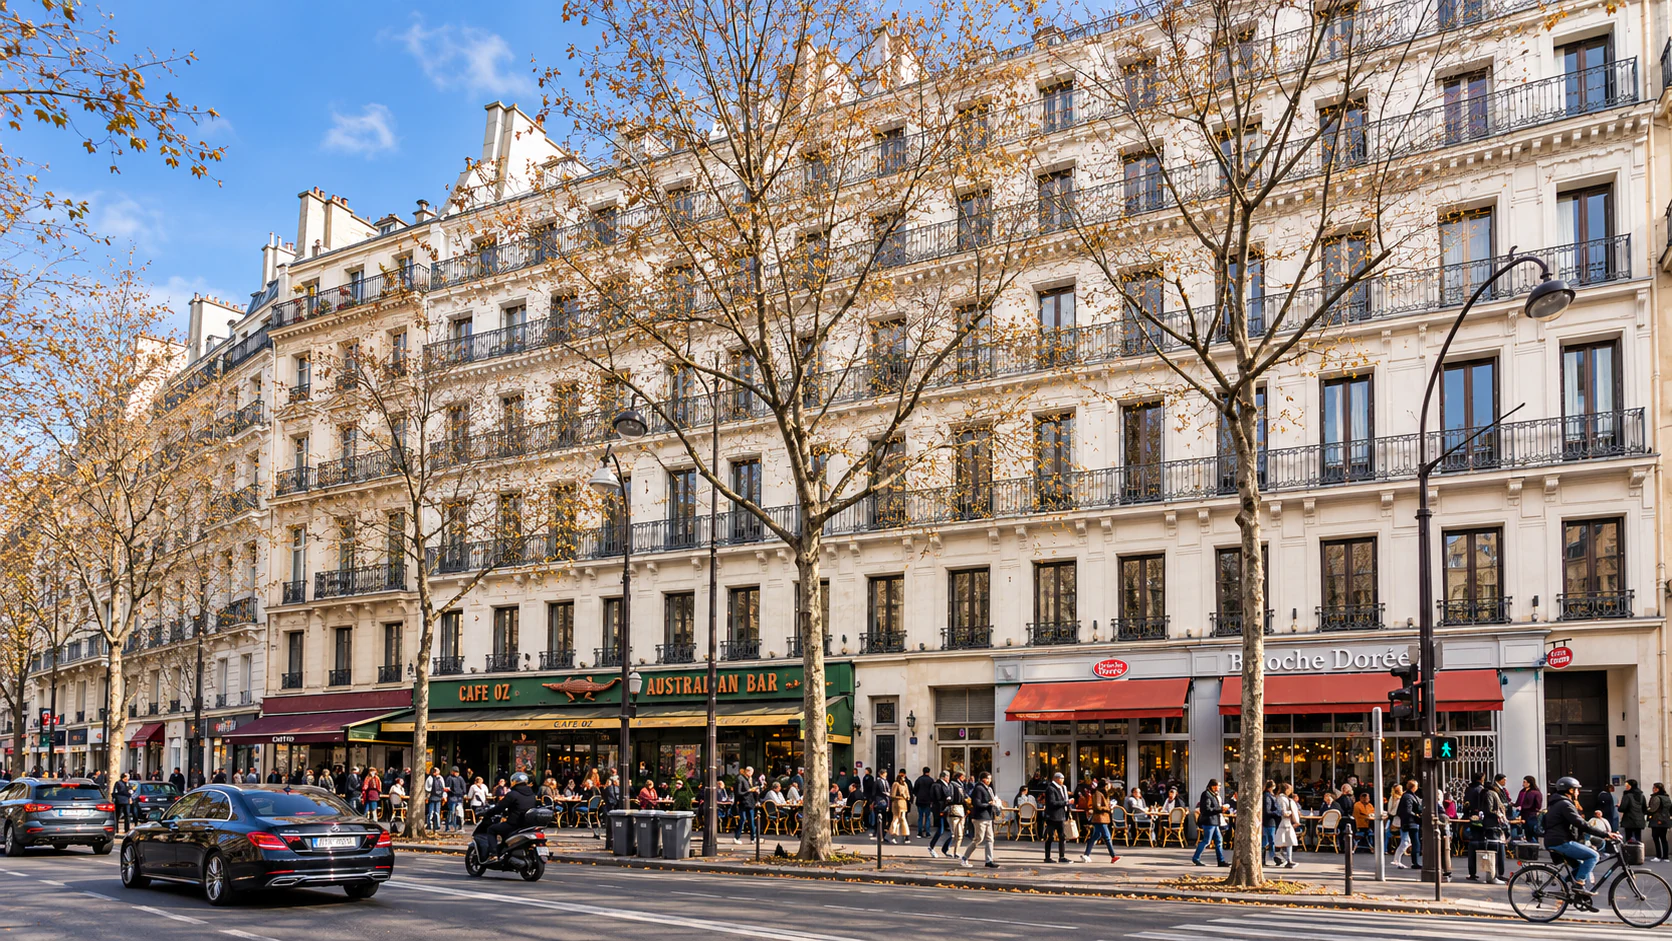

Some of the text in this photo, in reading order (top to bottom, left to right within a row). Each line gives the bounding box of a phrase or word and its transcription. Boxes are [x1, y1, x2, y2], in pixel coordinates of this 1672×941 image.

[1228, 647, 1412, 673] Boche Dorée
[458, 683, 510, 702] CAFE OZ
[646, 672, 778, 696] AUSTRALAN BAR
[553, 720, 593, 728] CAFE OZ
